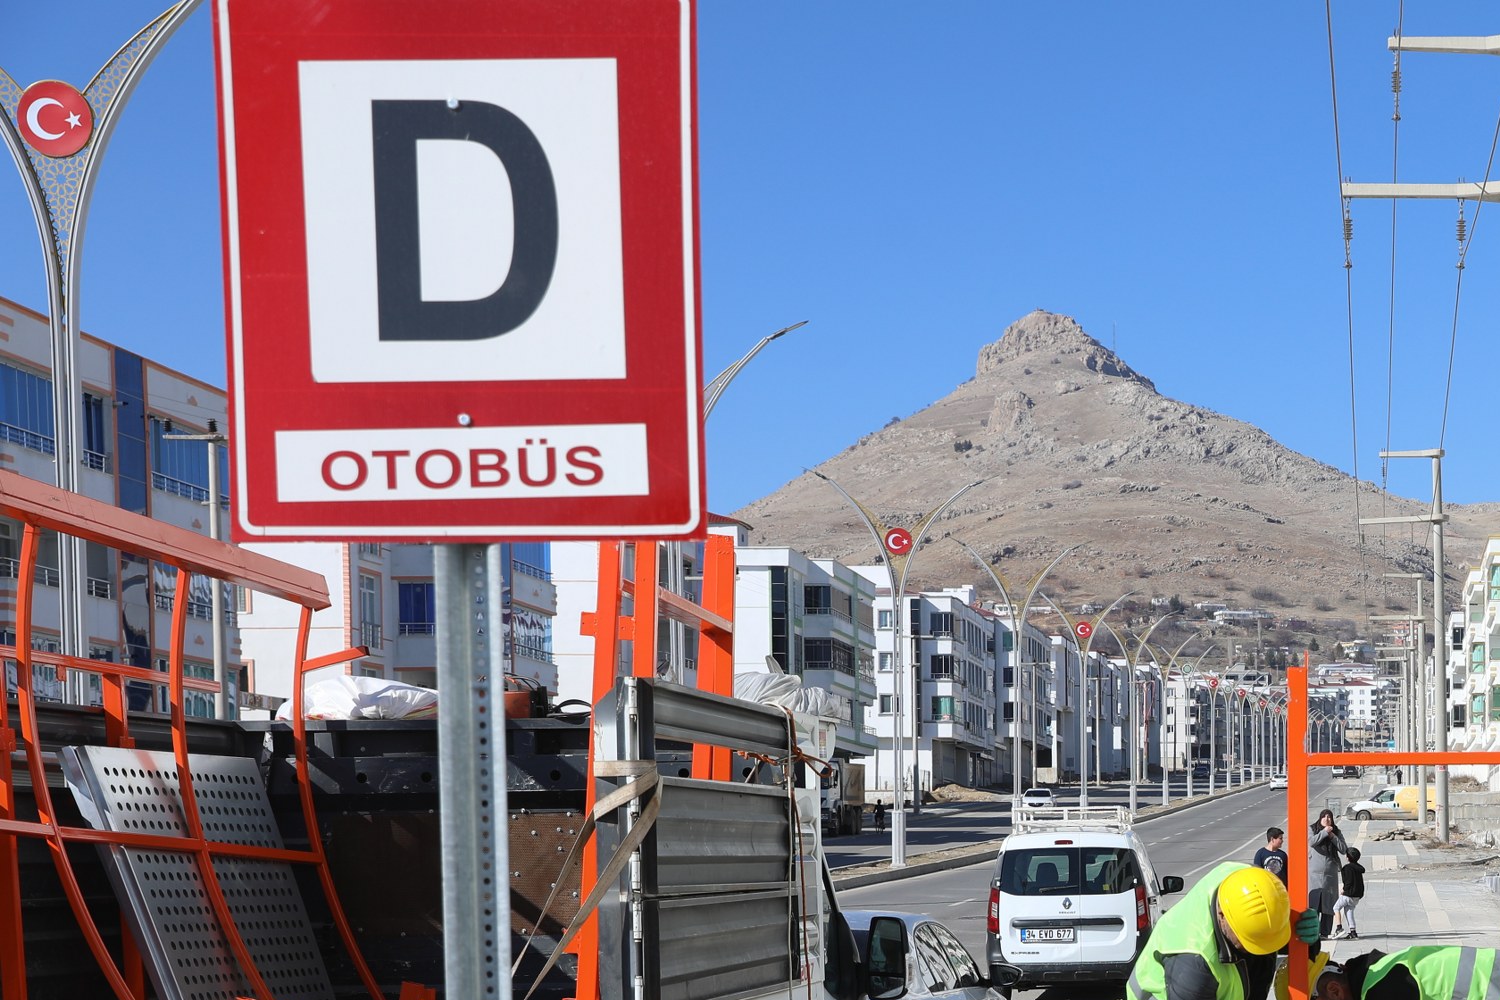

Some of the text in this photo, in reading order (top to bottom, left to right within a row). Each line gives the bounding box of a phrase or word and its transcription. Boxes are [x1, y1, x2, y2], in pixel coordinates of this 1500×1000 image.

[371, 99, 559, 341] D
[321, 438, 604, 491] OTOBÜS
[1026, 929, 1072, 939] 34 EVD 677
